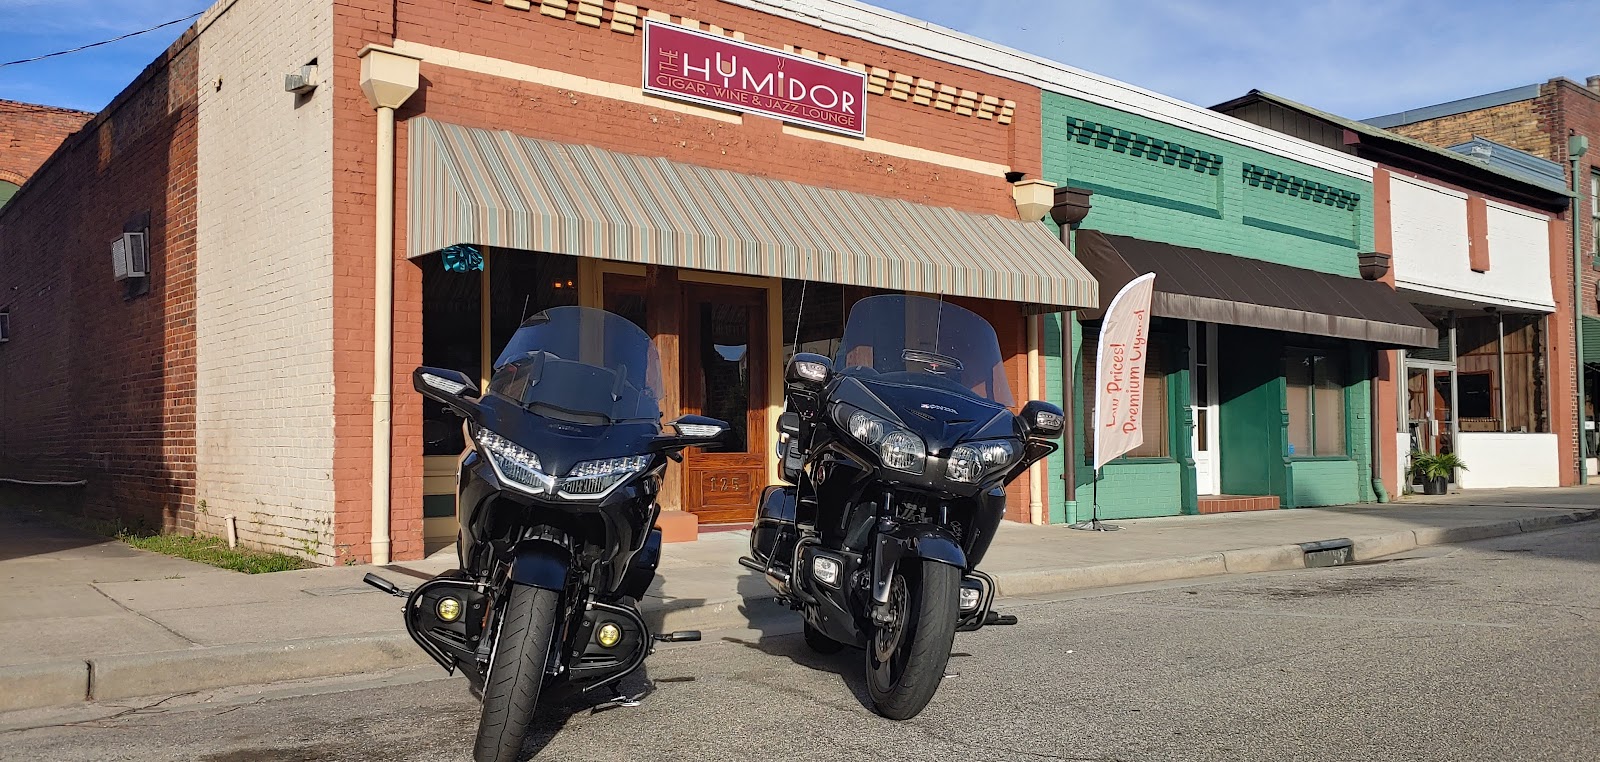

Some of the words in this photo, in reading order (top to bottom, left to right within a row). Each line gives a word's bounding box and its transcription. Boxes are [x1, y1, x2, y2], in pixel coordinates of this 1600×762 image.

[659, 47, 679, 72] THE
[656, 75, 709, 96] CIGAR,
[713, 86, 749, 104] WINE
[751, 95, 762, 106] &
[765, 98, 800, 115] JAZZ
[802, 106, 855, 127] LOUNGE
[1107, 343, 1126, 394] Prices!
[1122, 366, 1140, 434] Premium
[710, 477, 740, 492] 125
